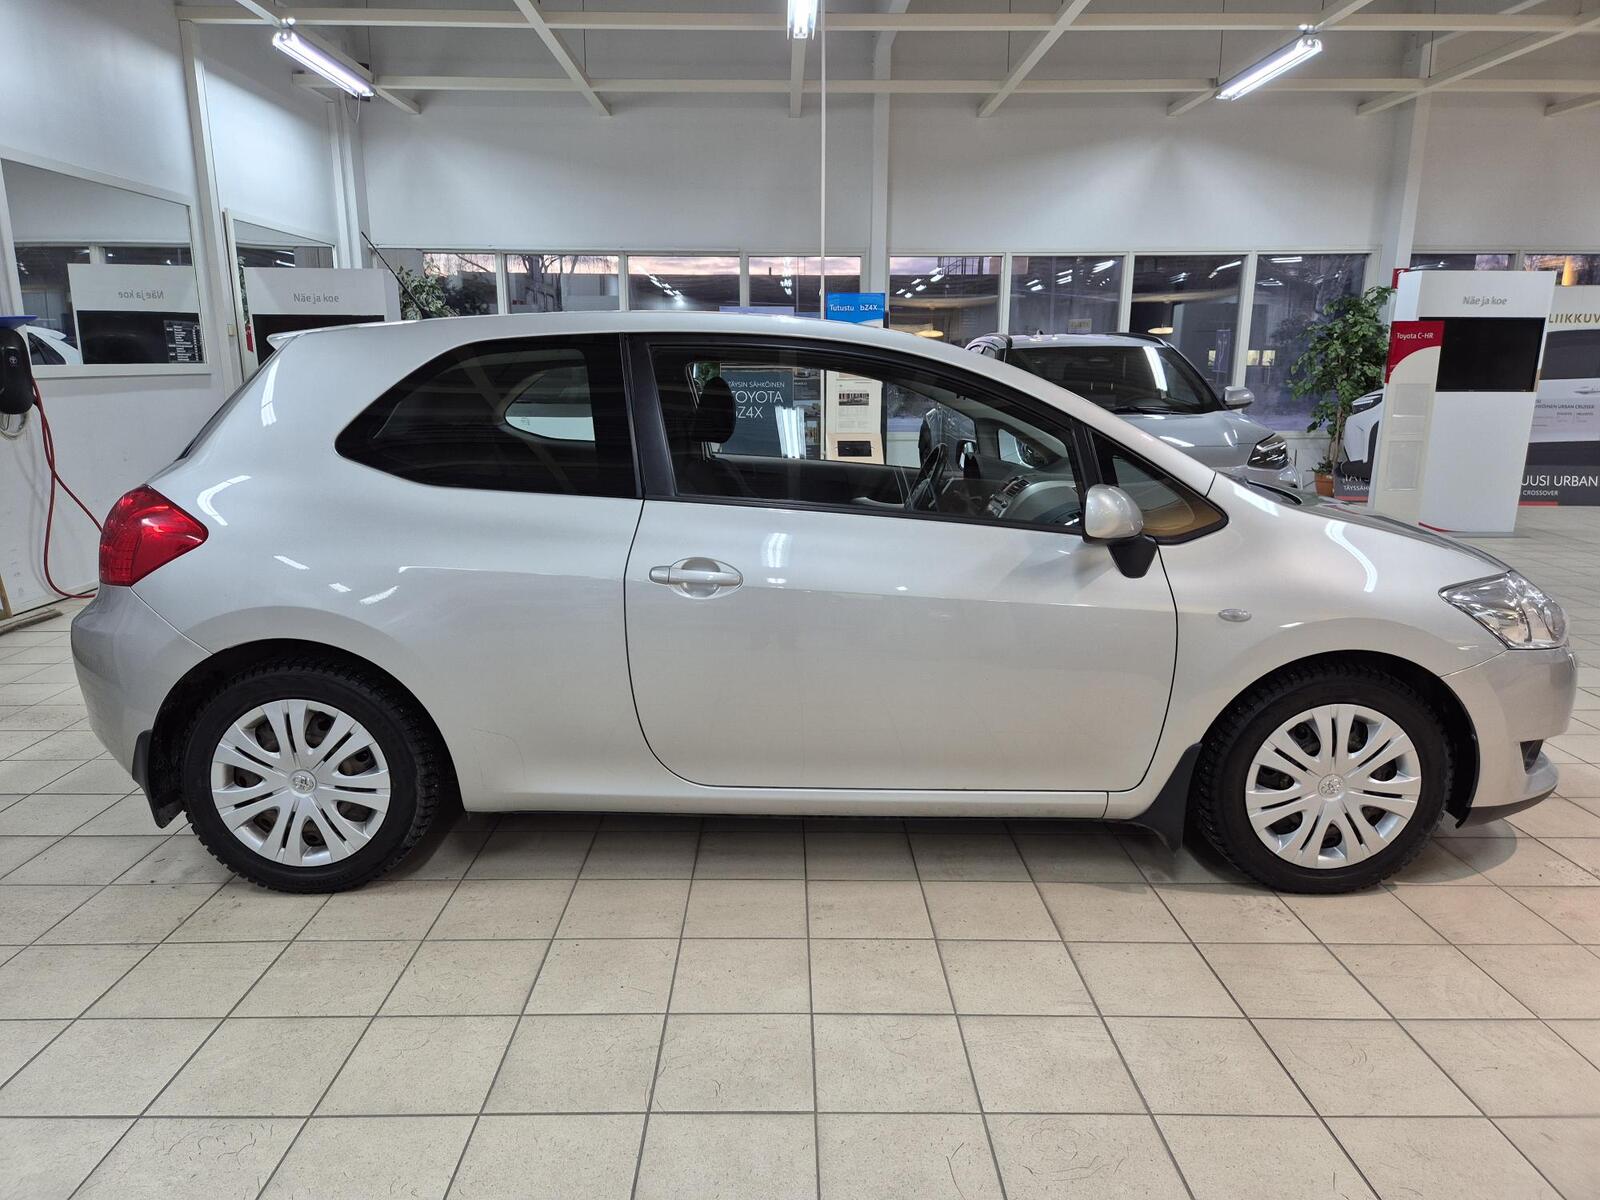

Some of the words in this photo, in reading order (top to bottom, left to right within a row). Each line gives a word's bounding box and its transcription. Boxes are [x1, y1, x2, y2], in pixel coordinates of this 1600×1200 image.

[293, 292, 311, 302] Näe
[312, 293, 321, 304] ja
[323, 292, 339, 302] koe
[1462, 296, 1480, 305] Näe
[1480, 296, 1489, 307] ja
[1491, 296, 1507, 305] koe
[1397, 332, 1417, 340] Toyota
[1554, 475, 1598, 486] URBAN
